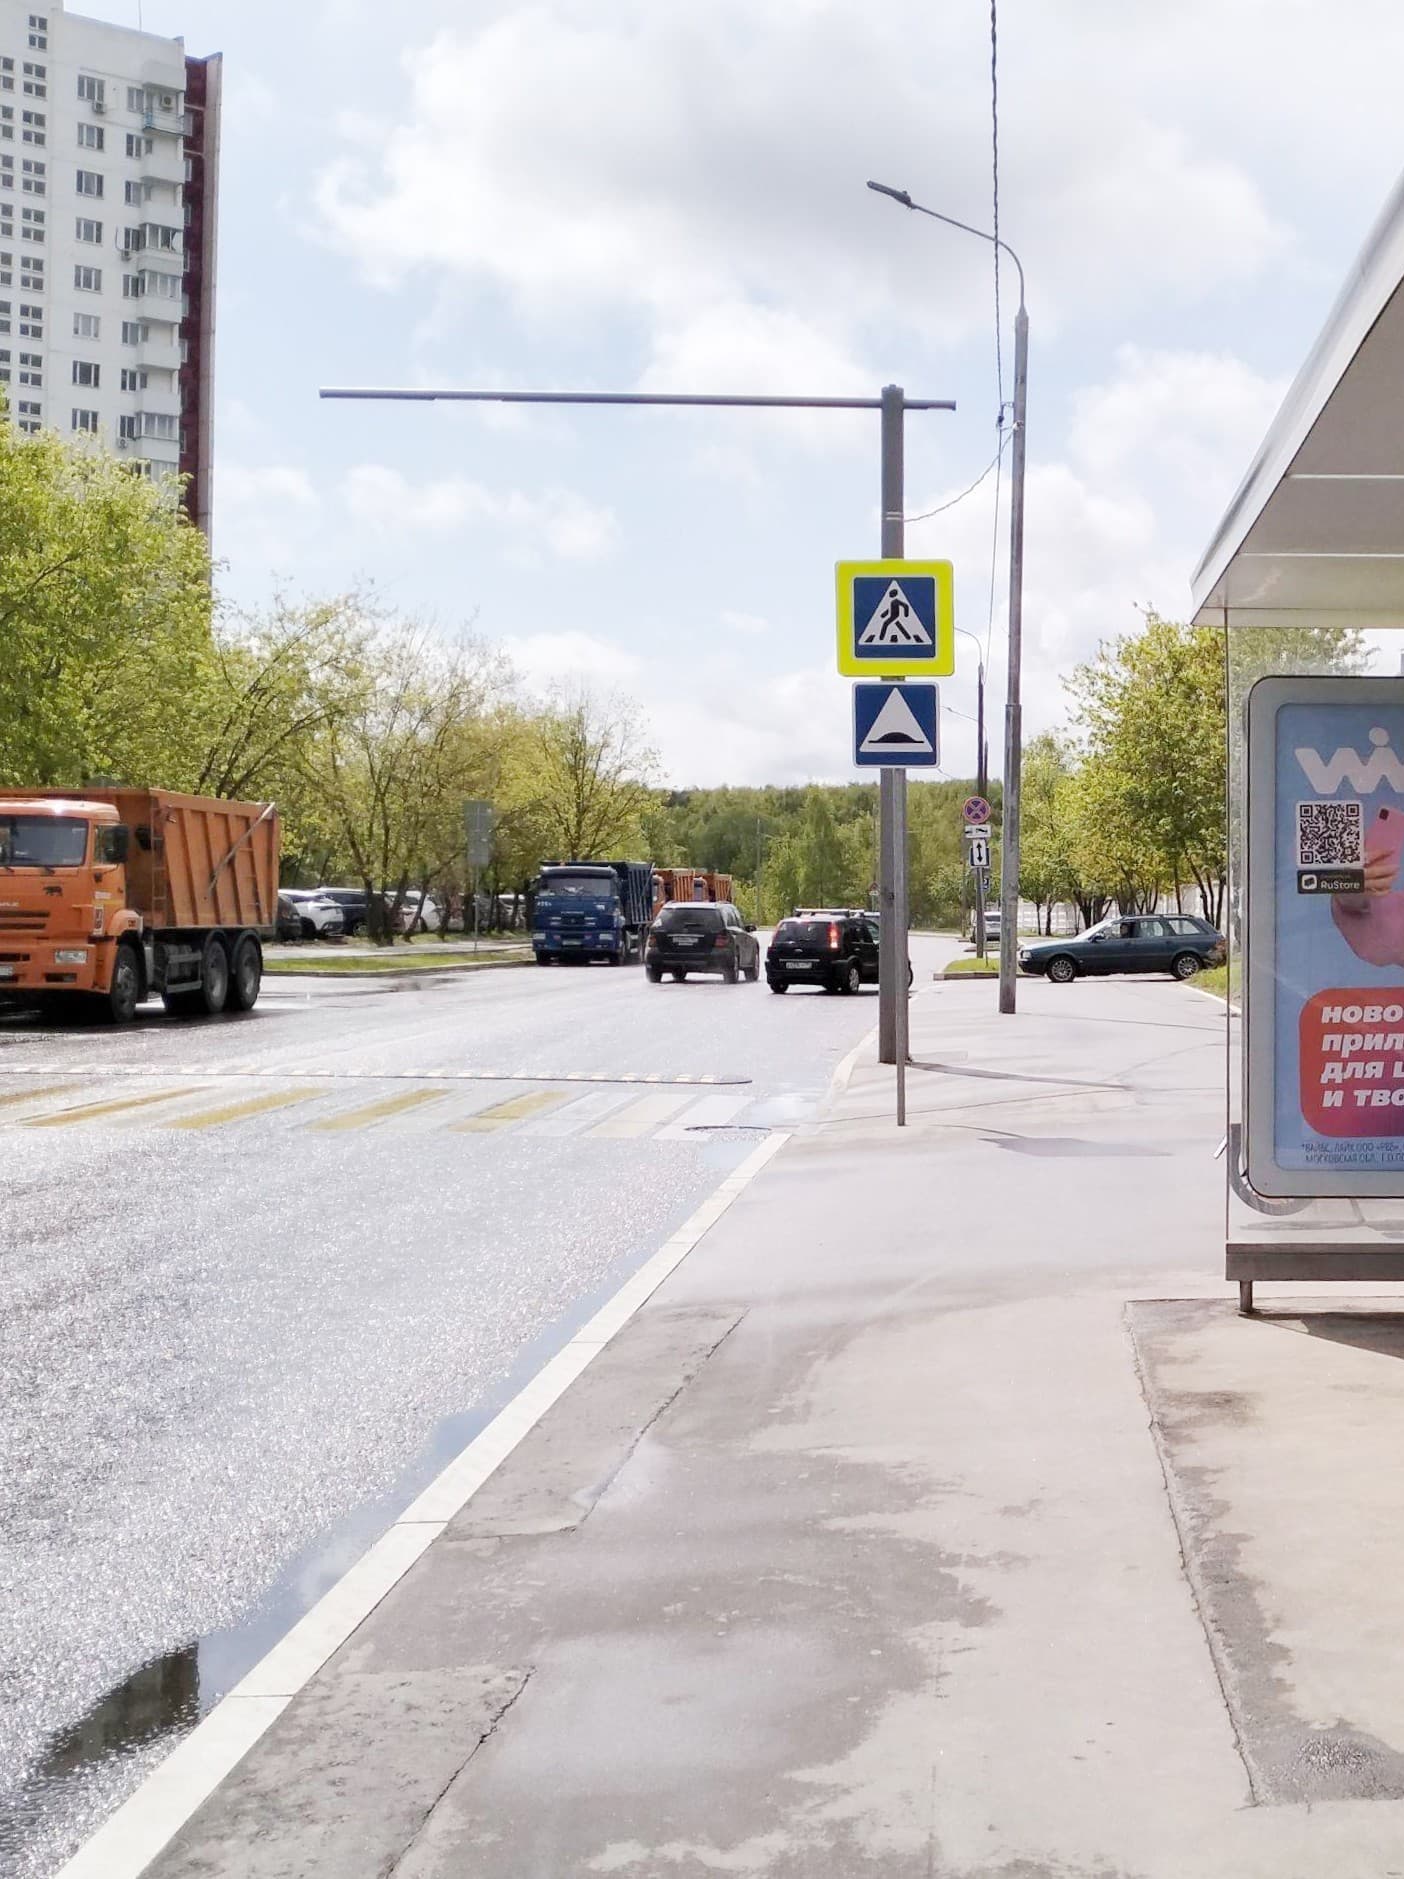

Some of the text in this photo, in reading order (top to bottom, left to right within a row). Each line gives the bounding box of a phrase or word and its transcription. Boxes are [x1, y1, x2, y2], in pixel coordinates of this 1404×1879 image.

[1320, 880, 1361, 890] RuStore
[1320, 1061, 1384, 1084] для
[1322, 1089, 1344, 1108] и
